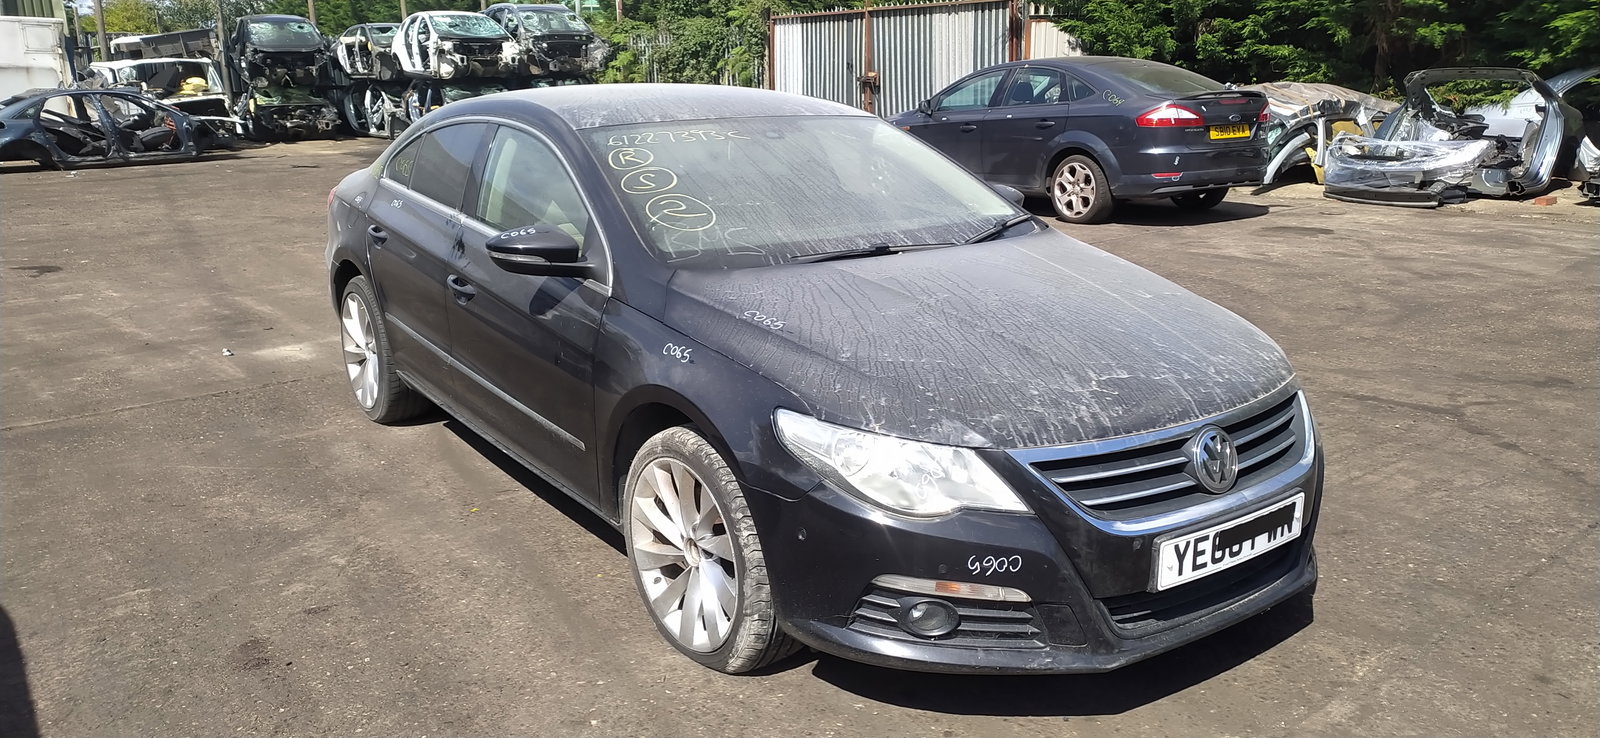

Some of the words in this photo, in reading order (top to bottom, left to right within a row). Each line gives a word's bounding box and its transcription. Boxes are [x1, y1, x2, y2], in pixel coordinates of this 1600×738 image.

[501, 227, 536, 239] C065
[743, 310, 786, 330] C065
[662, 343, 692, 363] C065
